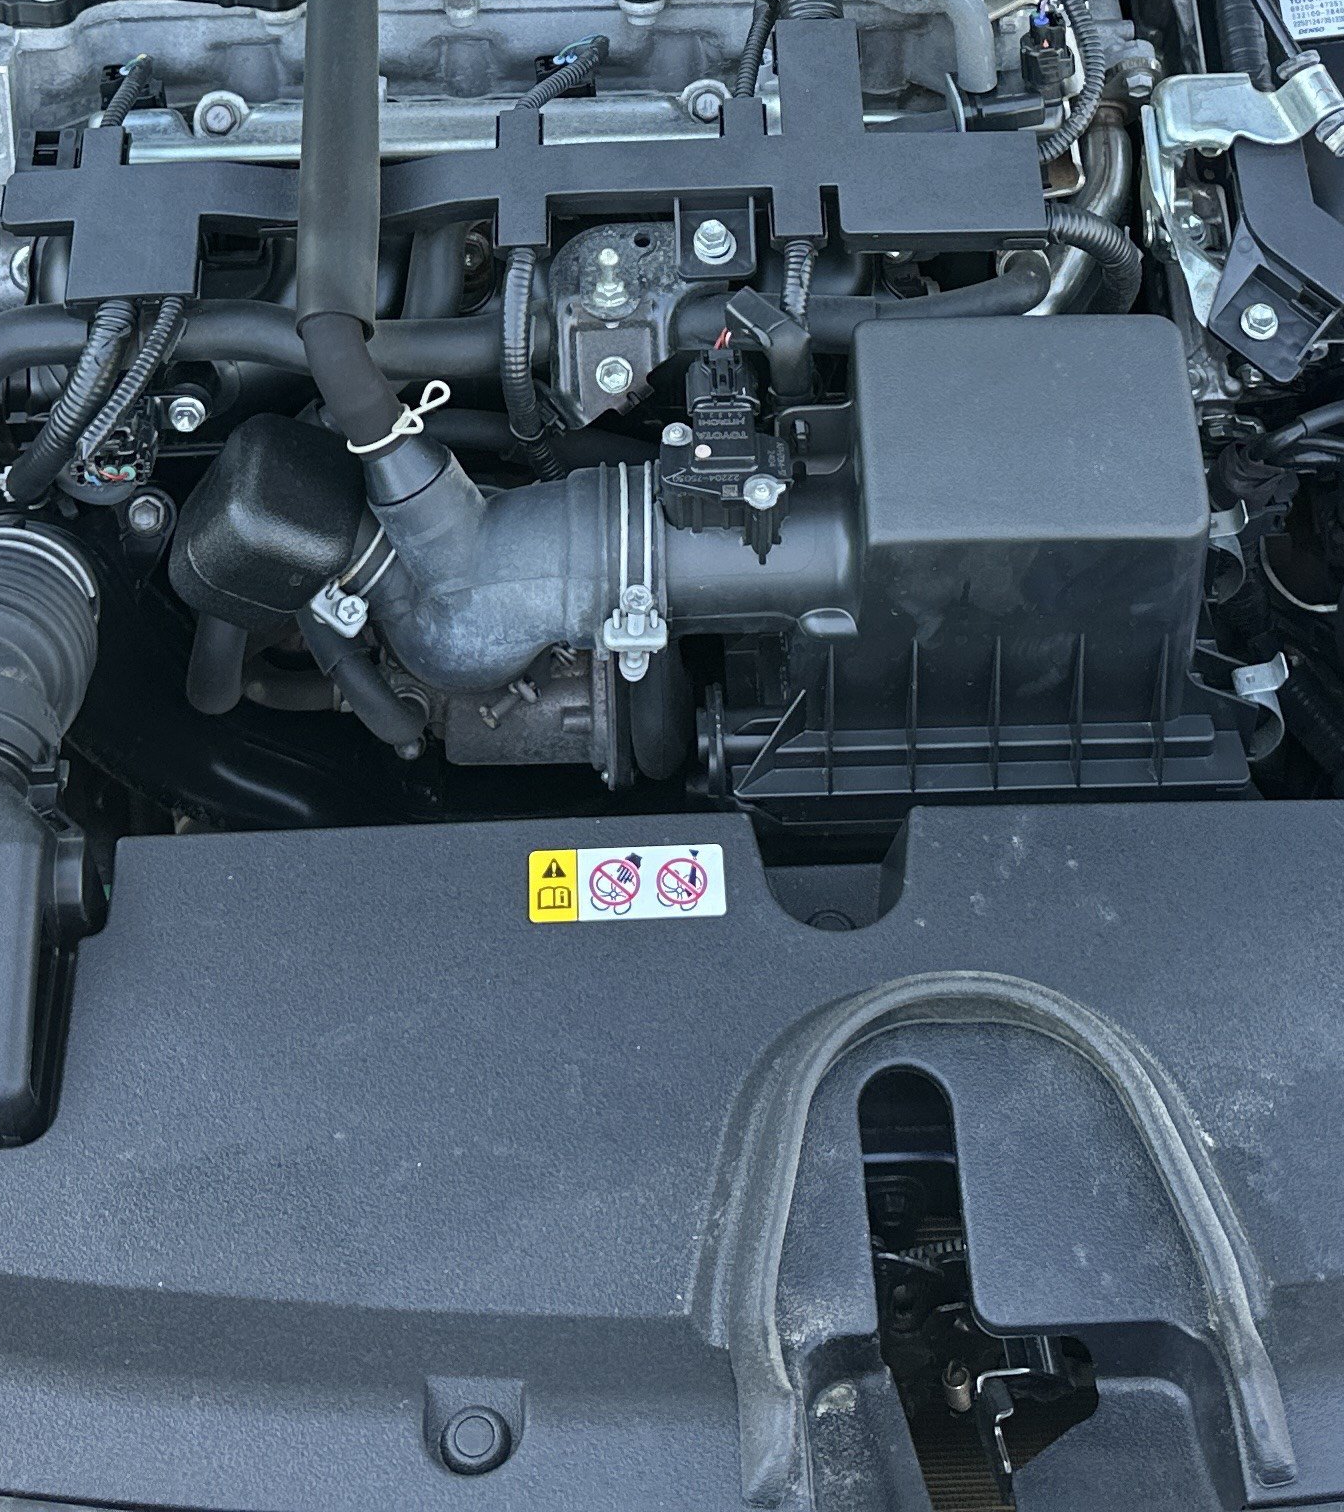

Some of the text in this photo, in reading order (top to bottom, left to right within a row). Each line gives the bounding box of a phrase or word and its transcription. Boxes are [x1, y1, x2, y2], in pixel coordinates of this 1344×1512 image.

[1298, 26, 1325, 34] DENSO
[697, 417, 746, 427] HITACHI
[695, 430, 749, 440] TOYOTA
